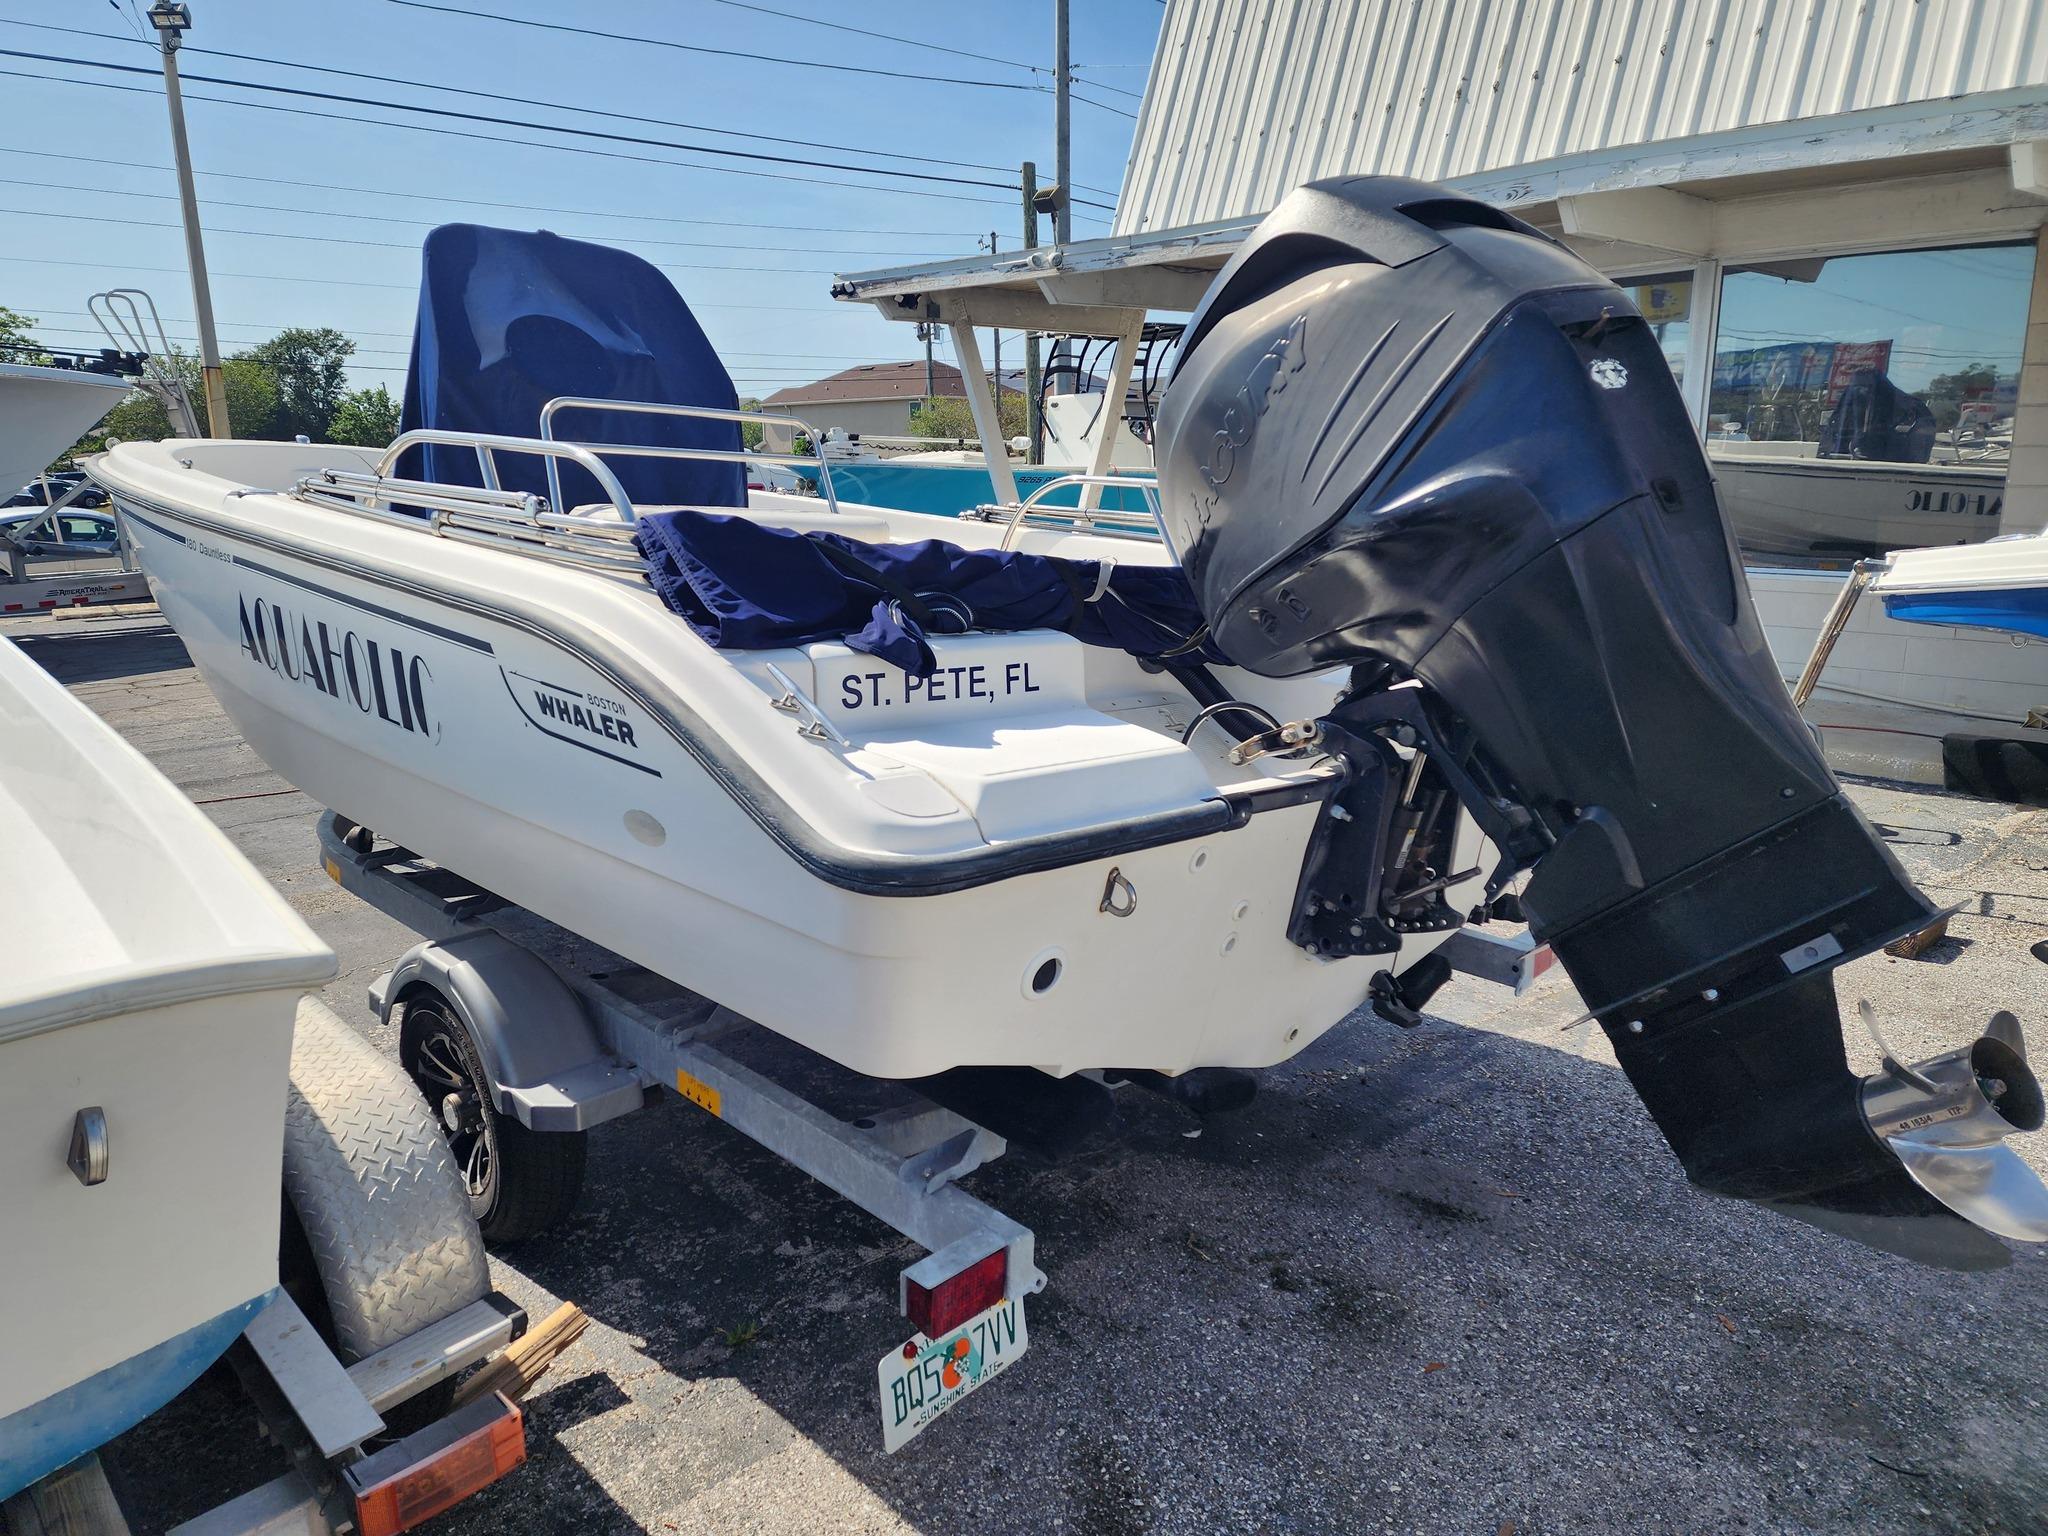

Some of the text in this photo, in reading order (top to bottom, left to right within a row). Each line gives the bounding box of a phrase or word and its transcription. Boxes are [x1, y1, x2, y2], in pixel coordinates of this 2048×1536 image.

[186, 537, 231, 564] 180 Dauntless
[239, 590, 442, 747] AQUAHOLIC
[841, 662, 1041, 710] ST. PETE, FL
[533, 690, 639, 749] WHALER
[586, 693, 627, 717] BOSTON
[919, 1361, 1001, 1425] SUNSHINE STATE
